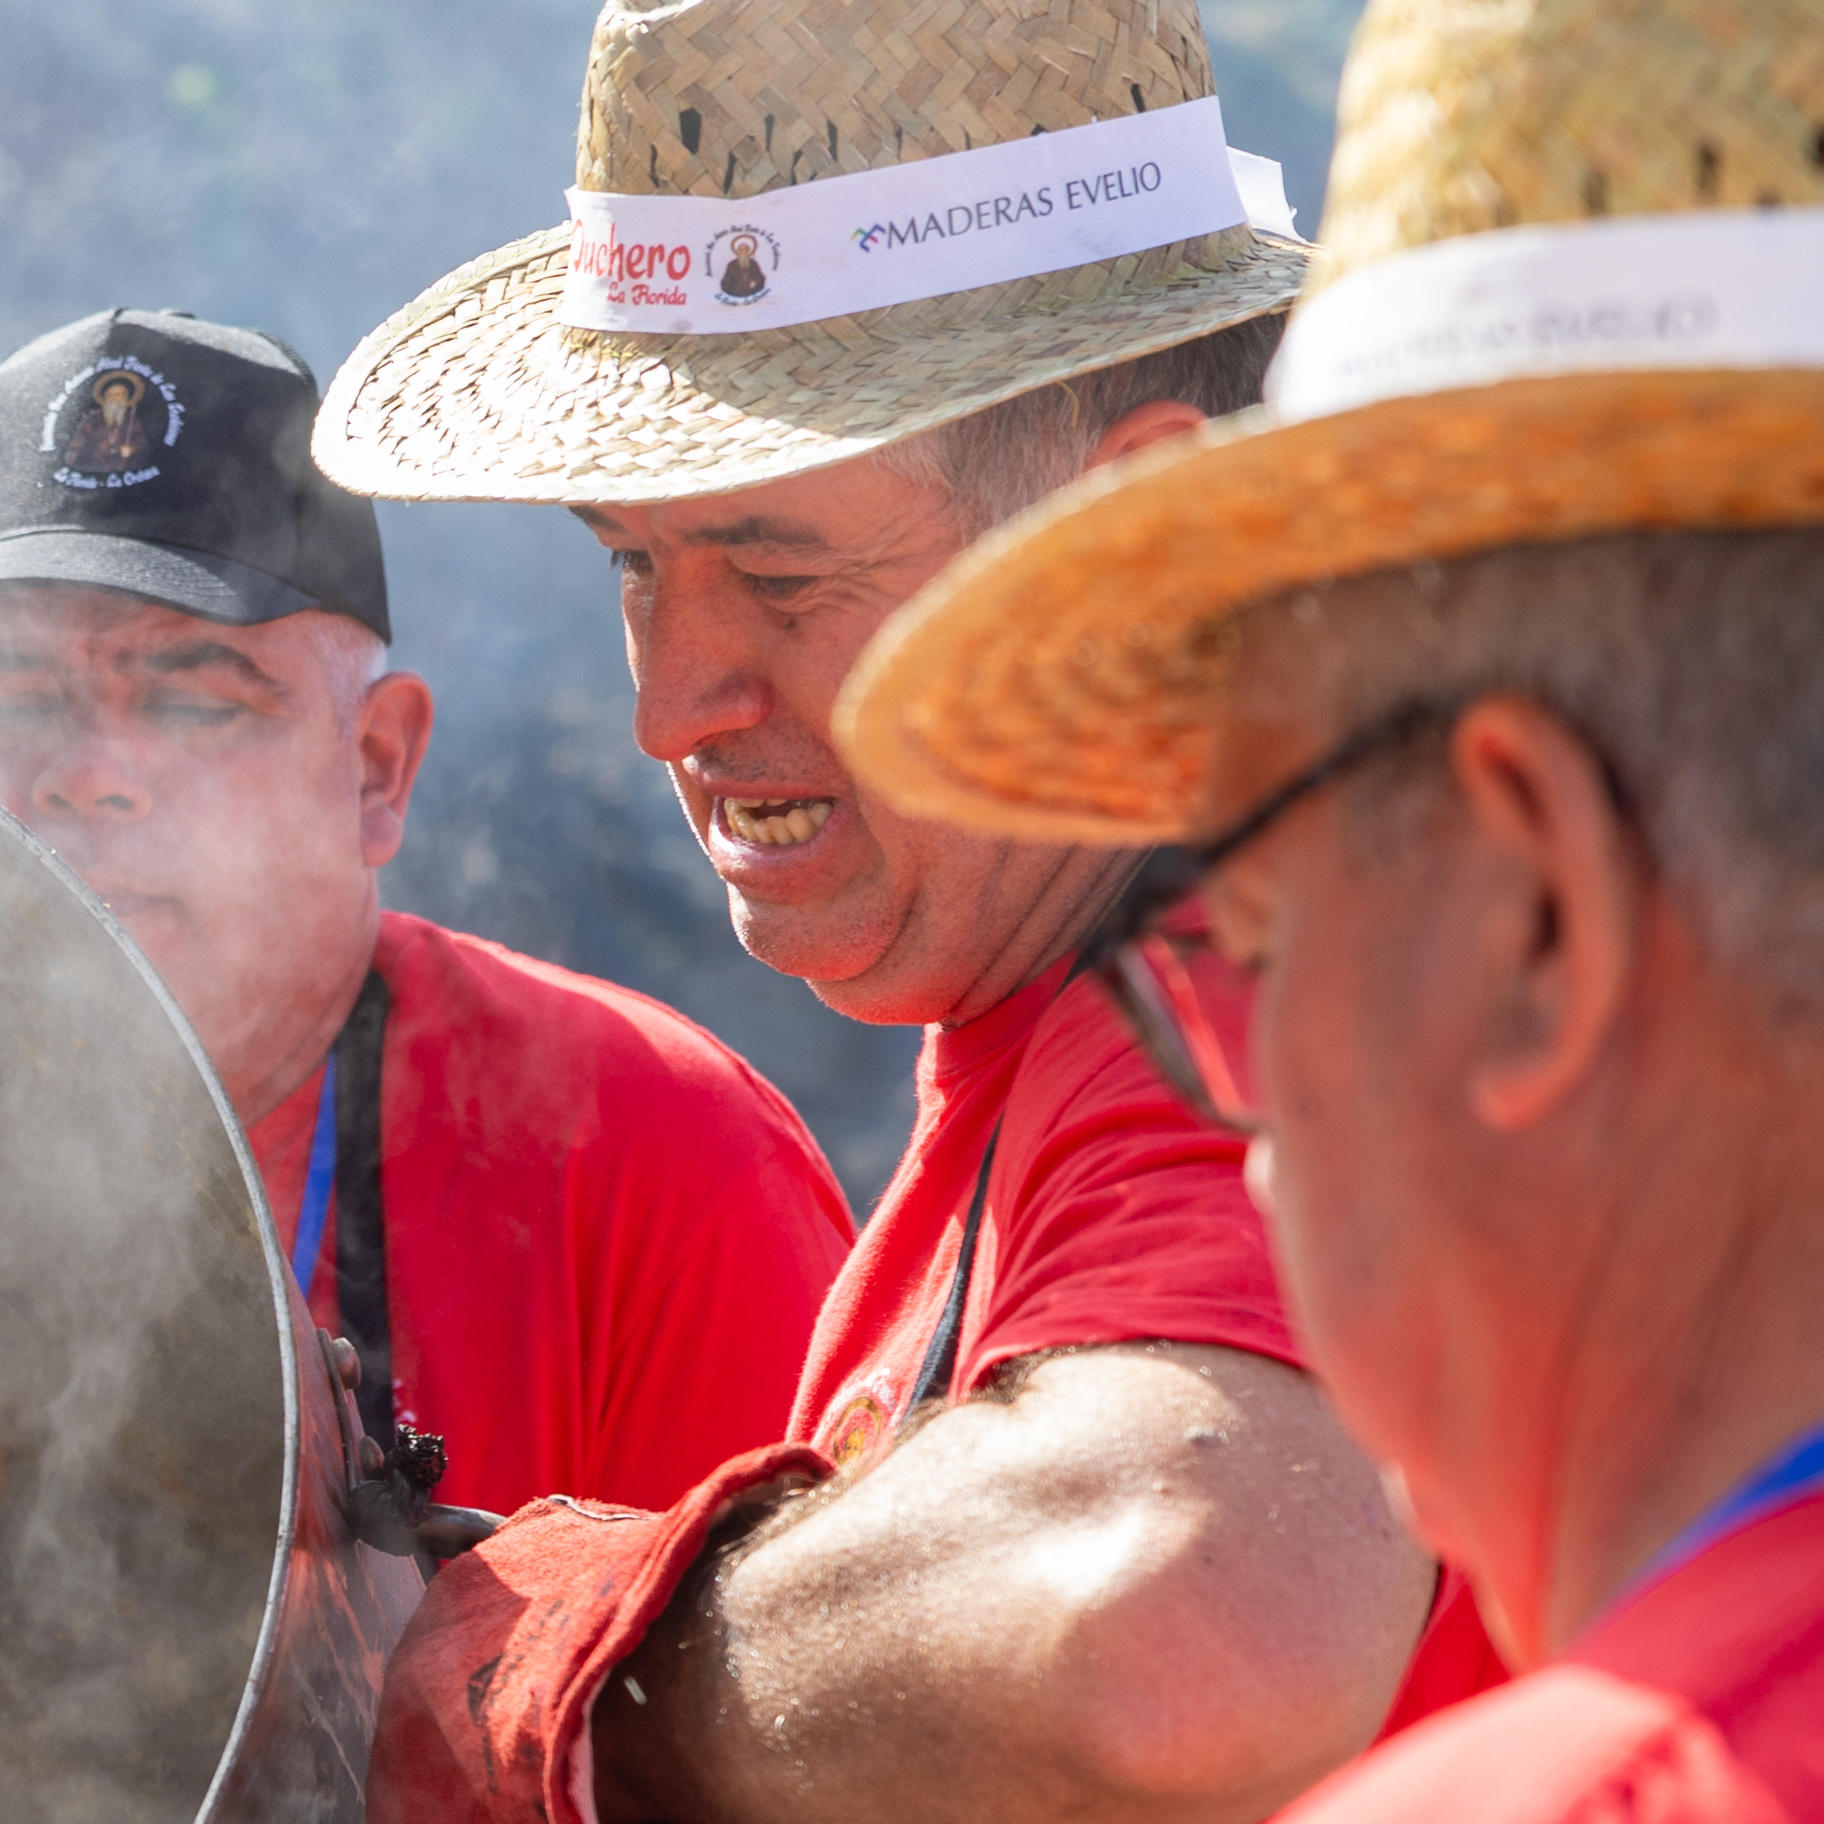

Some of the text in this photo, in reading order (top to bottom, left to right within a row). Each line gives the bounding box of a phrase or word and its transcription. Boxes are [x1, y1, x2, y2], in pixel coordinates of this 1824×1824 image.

[887, 162, 1162, 249] MADERAS EVELIO
[607, 281, 687, 306] La Florida
